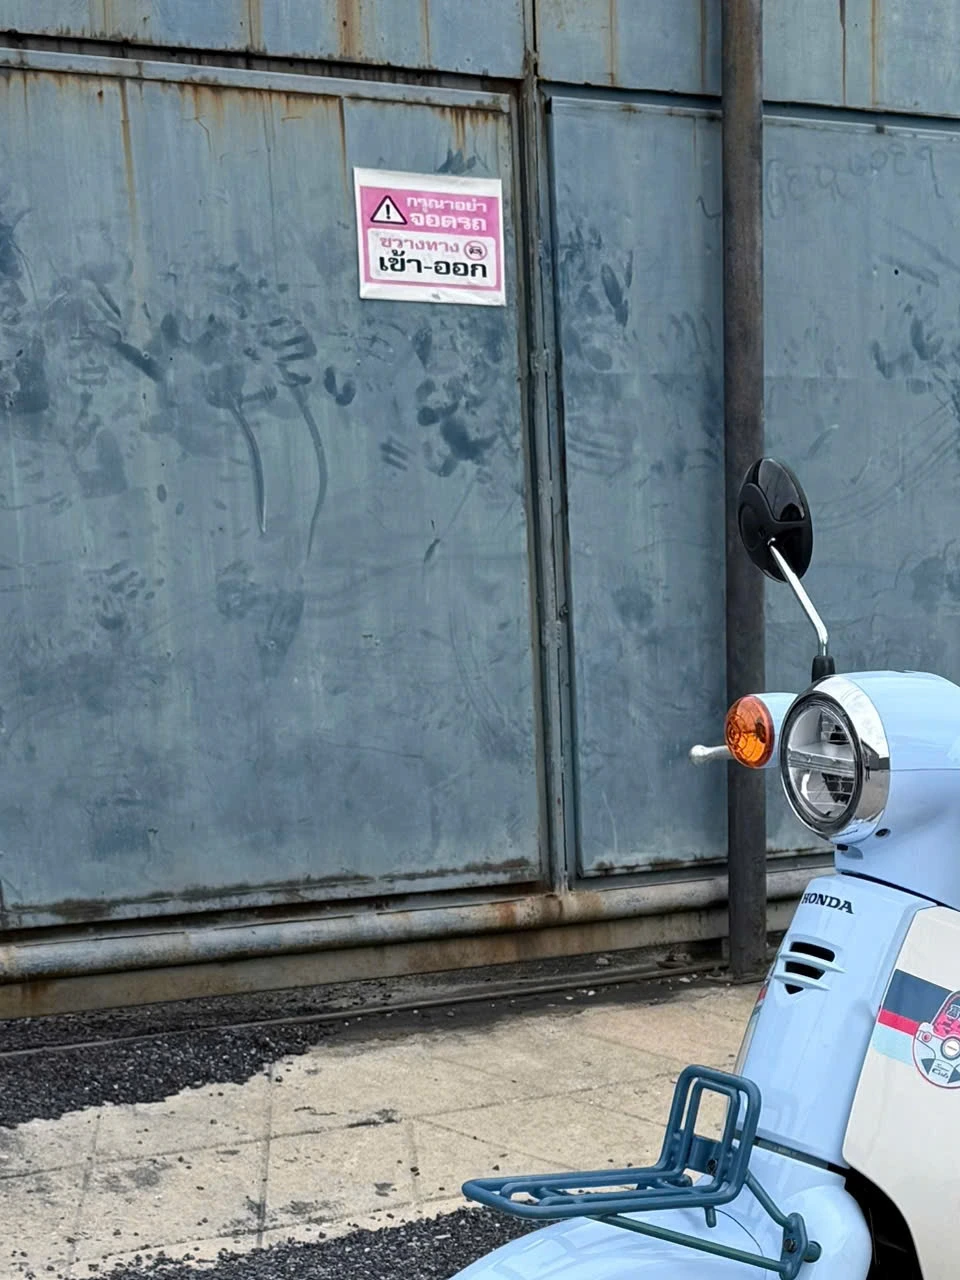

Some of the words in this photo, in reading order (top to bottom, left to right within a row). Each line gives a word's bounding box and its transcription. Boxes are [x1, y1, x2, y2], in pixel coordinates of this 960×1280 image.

[407, 196, 487, 213] กรุณาอย่า
[410, 213, 487, 231] จอดรถ
[380, 237, 460, 253] ขวางทาง
[379, 249, 487, 278] เข้า-ออก
[801, 892, 854, 914] HONDA
